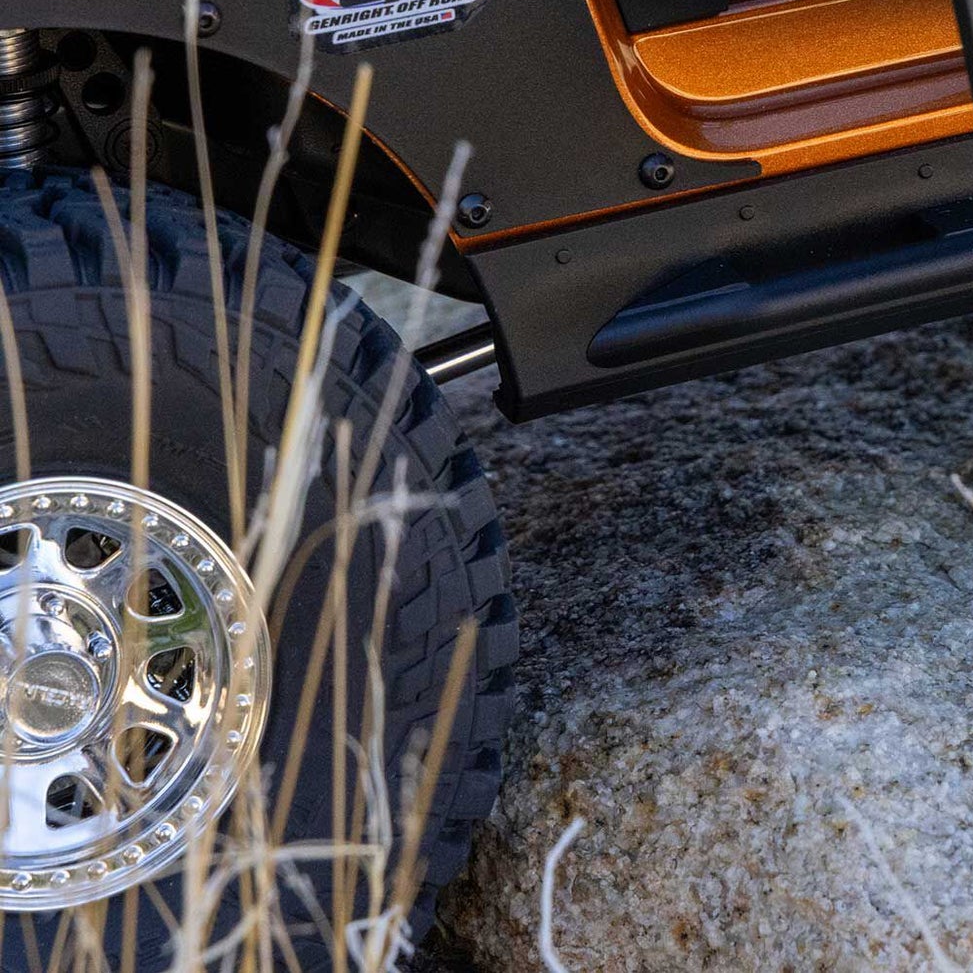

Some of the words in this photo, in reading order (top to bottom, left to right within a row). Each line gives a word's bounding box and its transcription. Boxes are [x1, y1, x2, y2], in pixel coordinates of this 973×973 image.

[336, 28, 373, 42] MADE
[373, 24, 388, 34] IN
[389, 19, 412, 31] THE
[415, 13, 439, 26] USA
